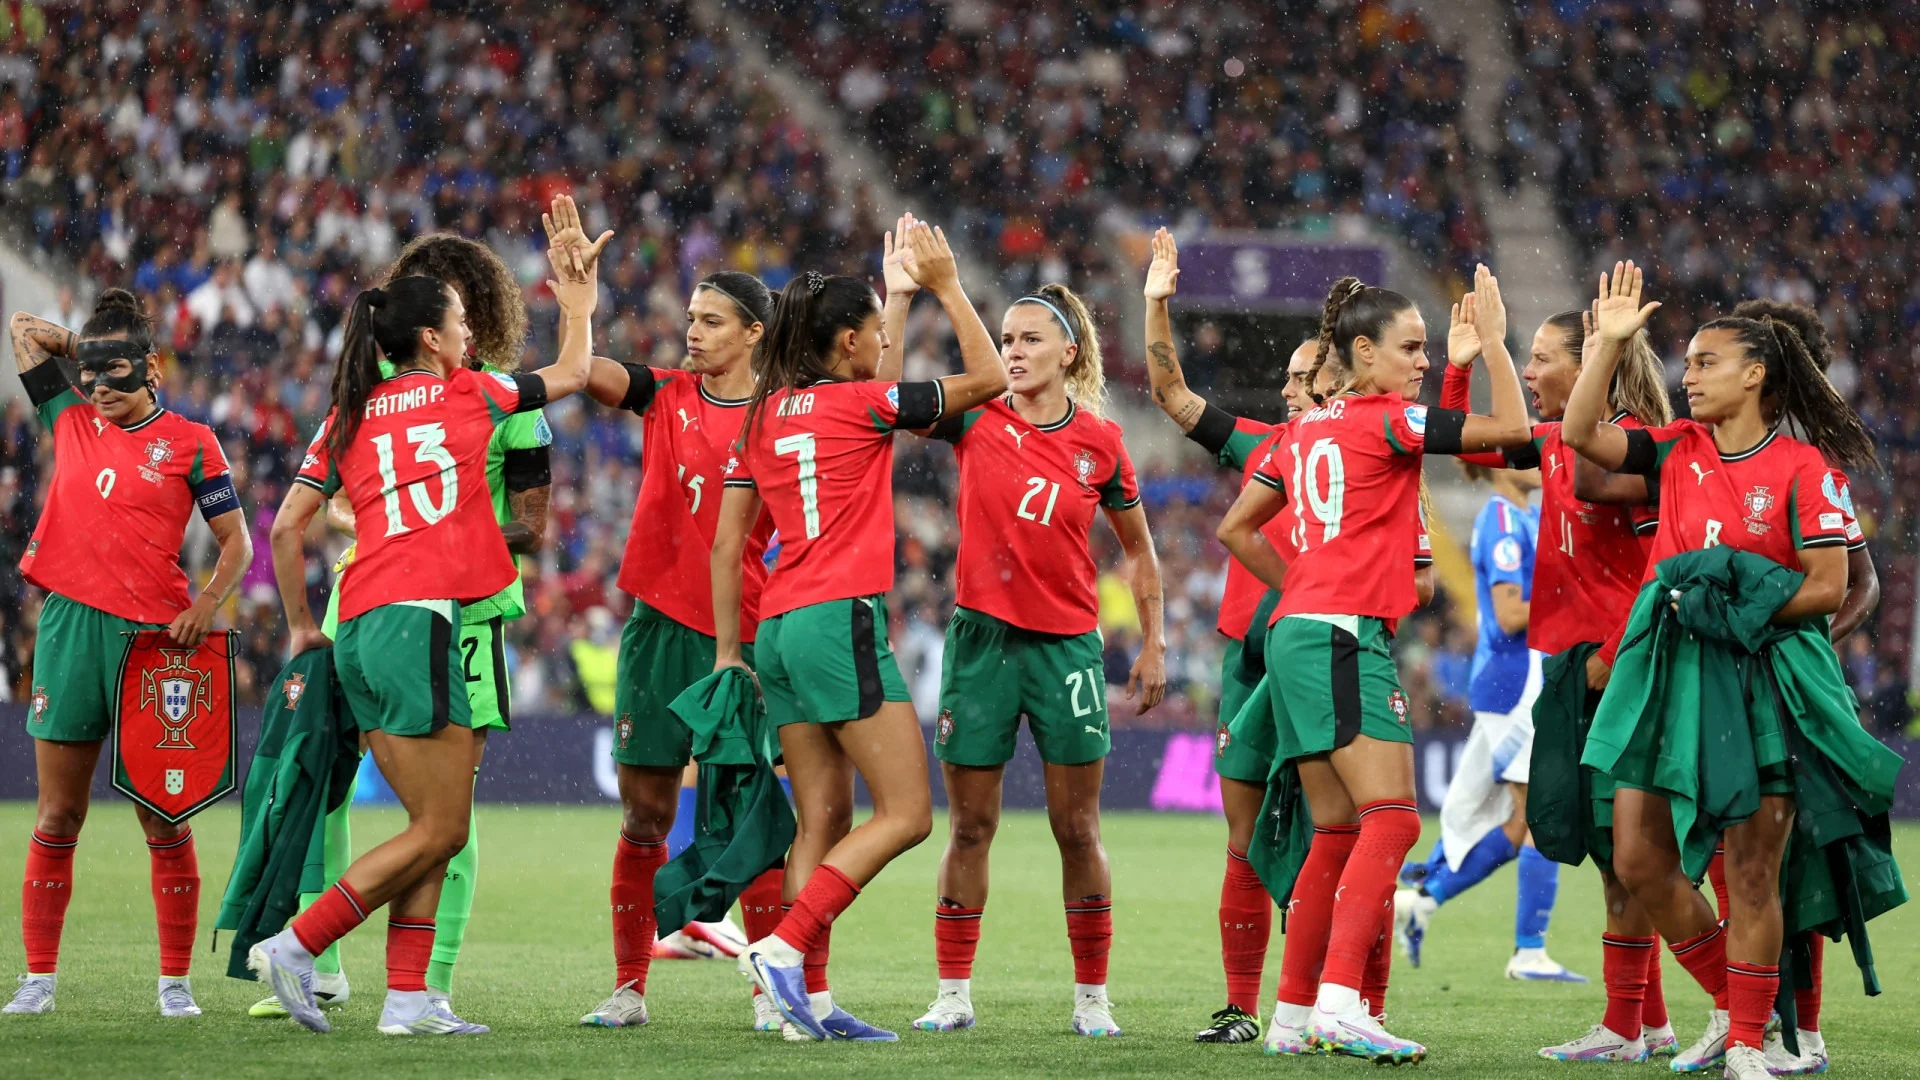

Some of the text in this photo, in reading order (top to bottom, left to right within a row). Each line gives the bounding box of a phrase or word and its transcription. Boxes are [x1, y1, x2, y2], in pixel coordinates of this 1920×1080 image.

[365, 384, 445, 420] FÁTIMA P.
[776, 393, 815, 417] KIKA
[200, 488, 231, 506] RESPECT
[369, 422, 459, 538] 13
[774, 433, 820, 540] 7
[1016, 476, 1061, 527] 21
[1290, 437, 1345, 553] 19
[1558, 510, 1575, 558] 11
[1703, 518, 1723, 549] 8
[461, 636, 482, 682] 2
[1065, 668, 1103, 718] 21
